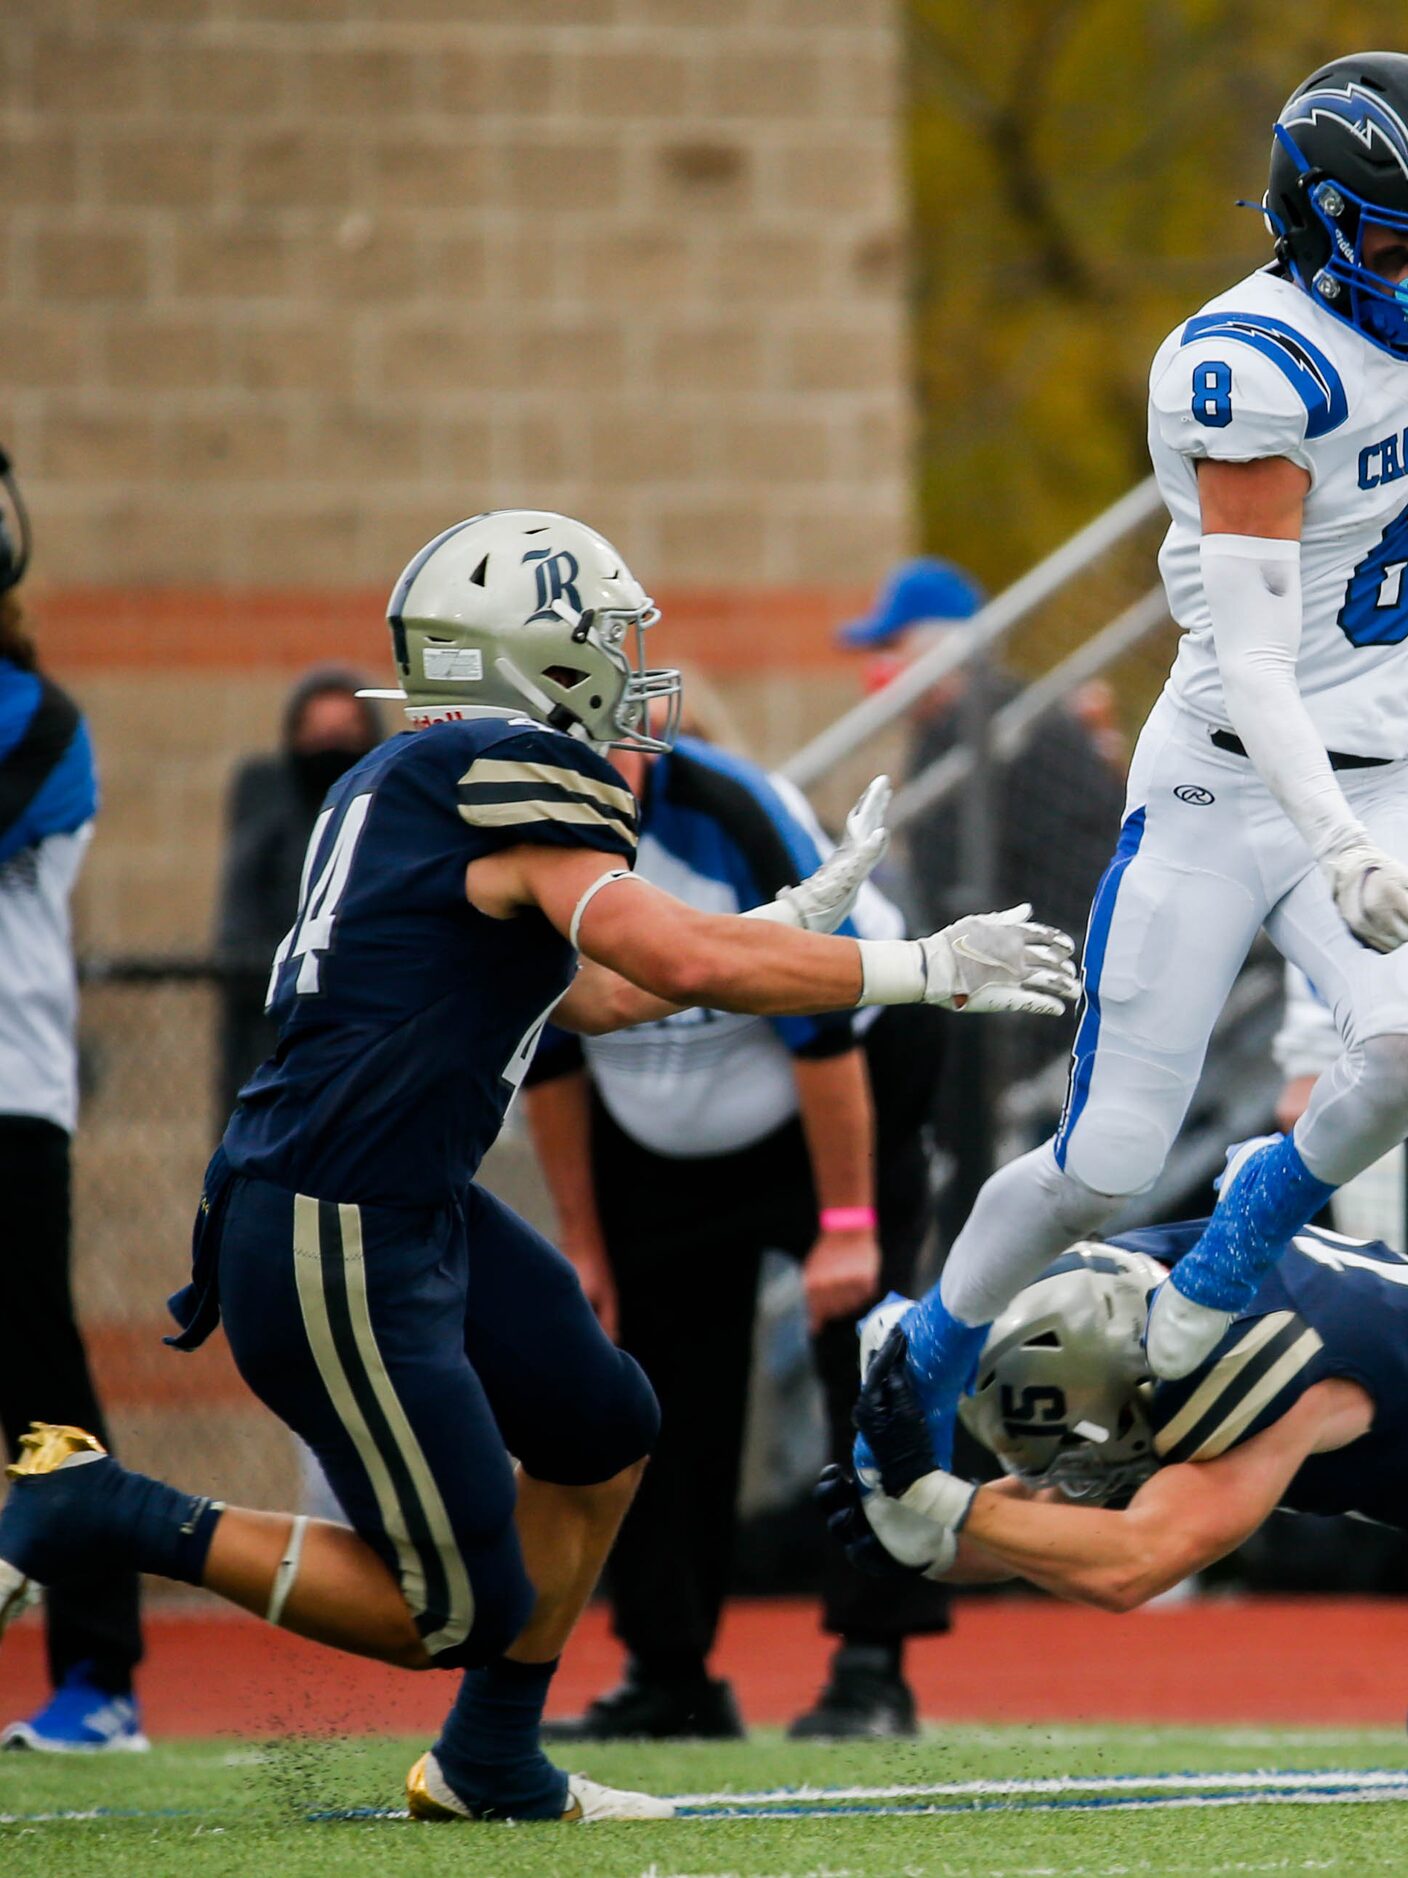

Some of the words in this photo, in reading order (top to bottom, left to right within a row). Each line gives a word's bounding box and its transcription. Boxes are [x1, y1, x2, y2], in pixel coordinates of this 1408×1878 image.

[1192, 361, 1232, 428] 8
[522, 548, 583, 625] R
[265, 793, 372, 1014] 44
[1000, 1385, 1068, 1438] 15
